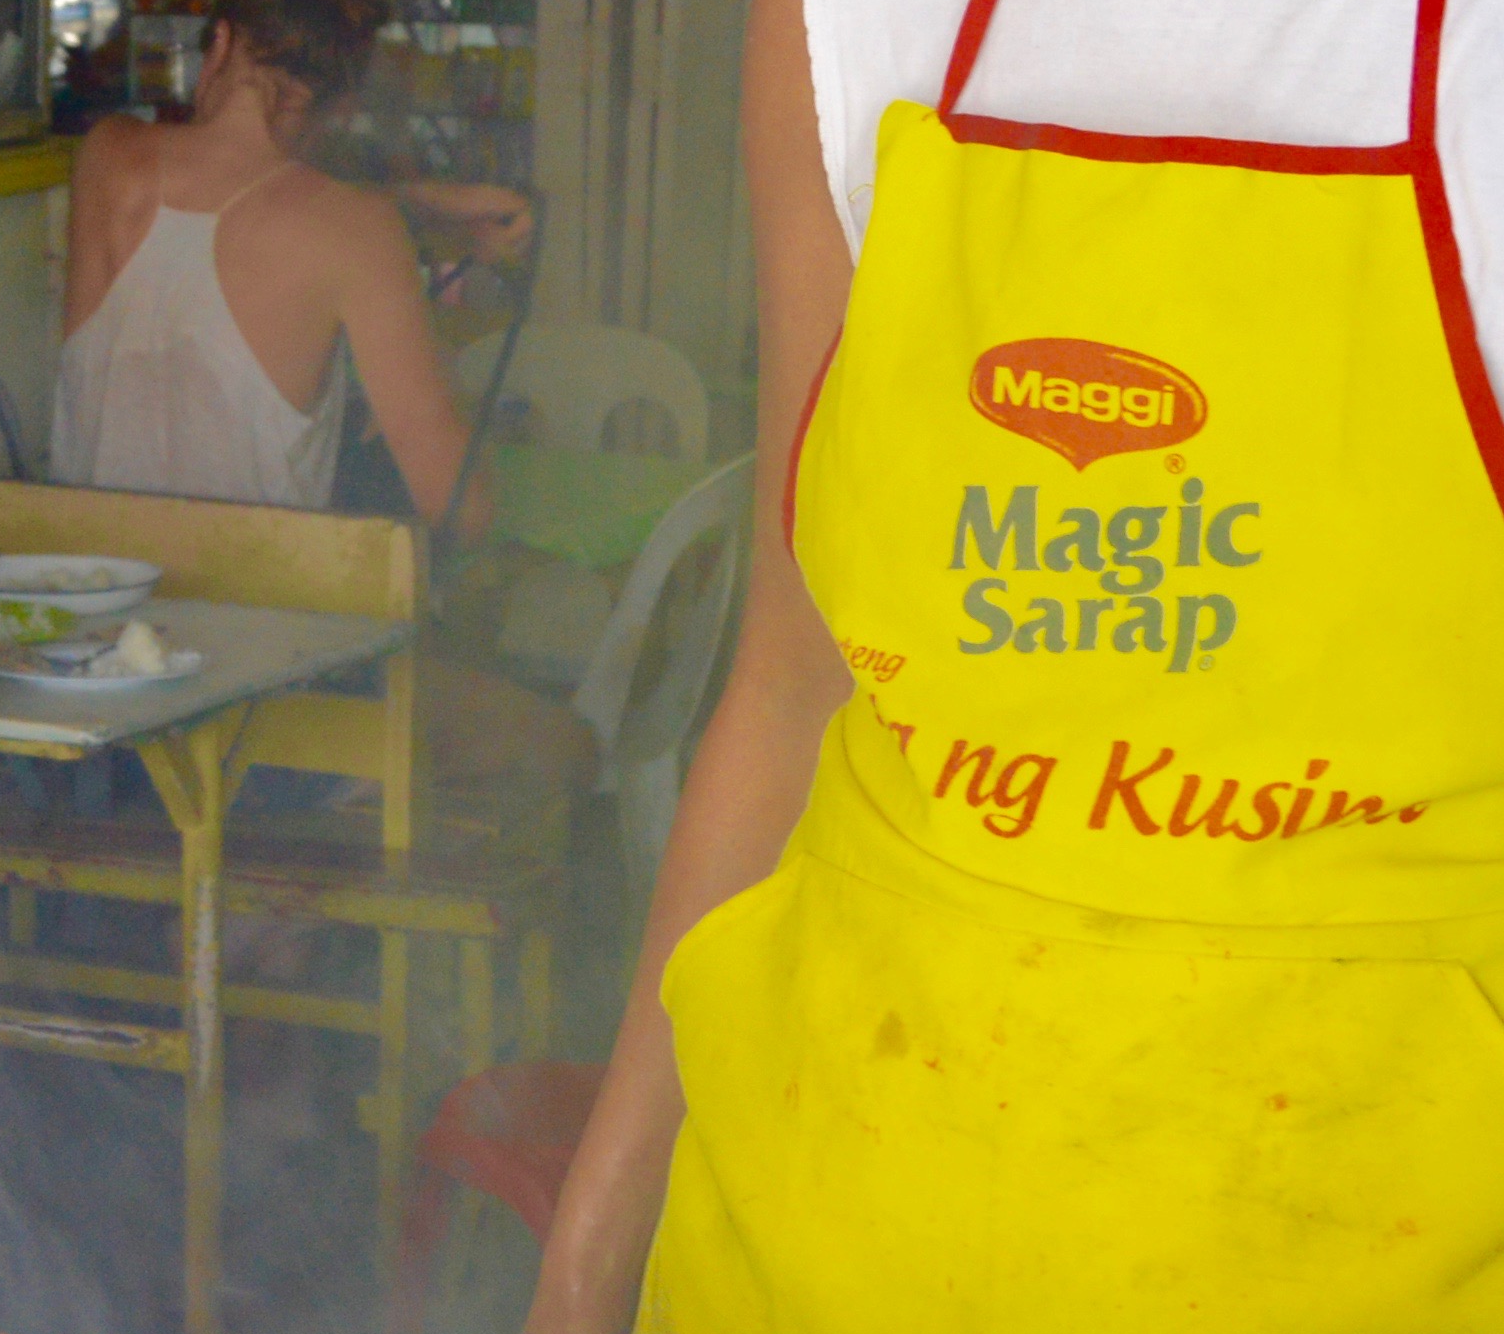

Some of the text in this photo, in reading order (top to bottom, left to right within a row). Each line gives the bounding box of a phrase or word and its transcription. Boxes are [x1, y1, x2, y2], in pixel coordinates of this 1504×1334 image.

[992, 367, 1176, 428] Maggi
[948, 477, 1263, 596] Magic
[957, 578, 1237, 675] Sarap
